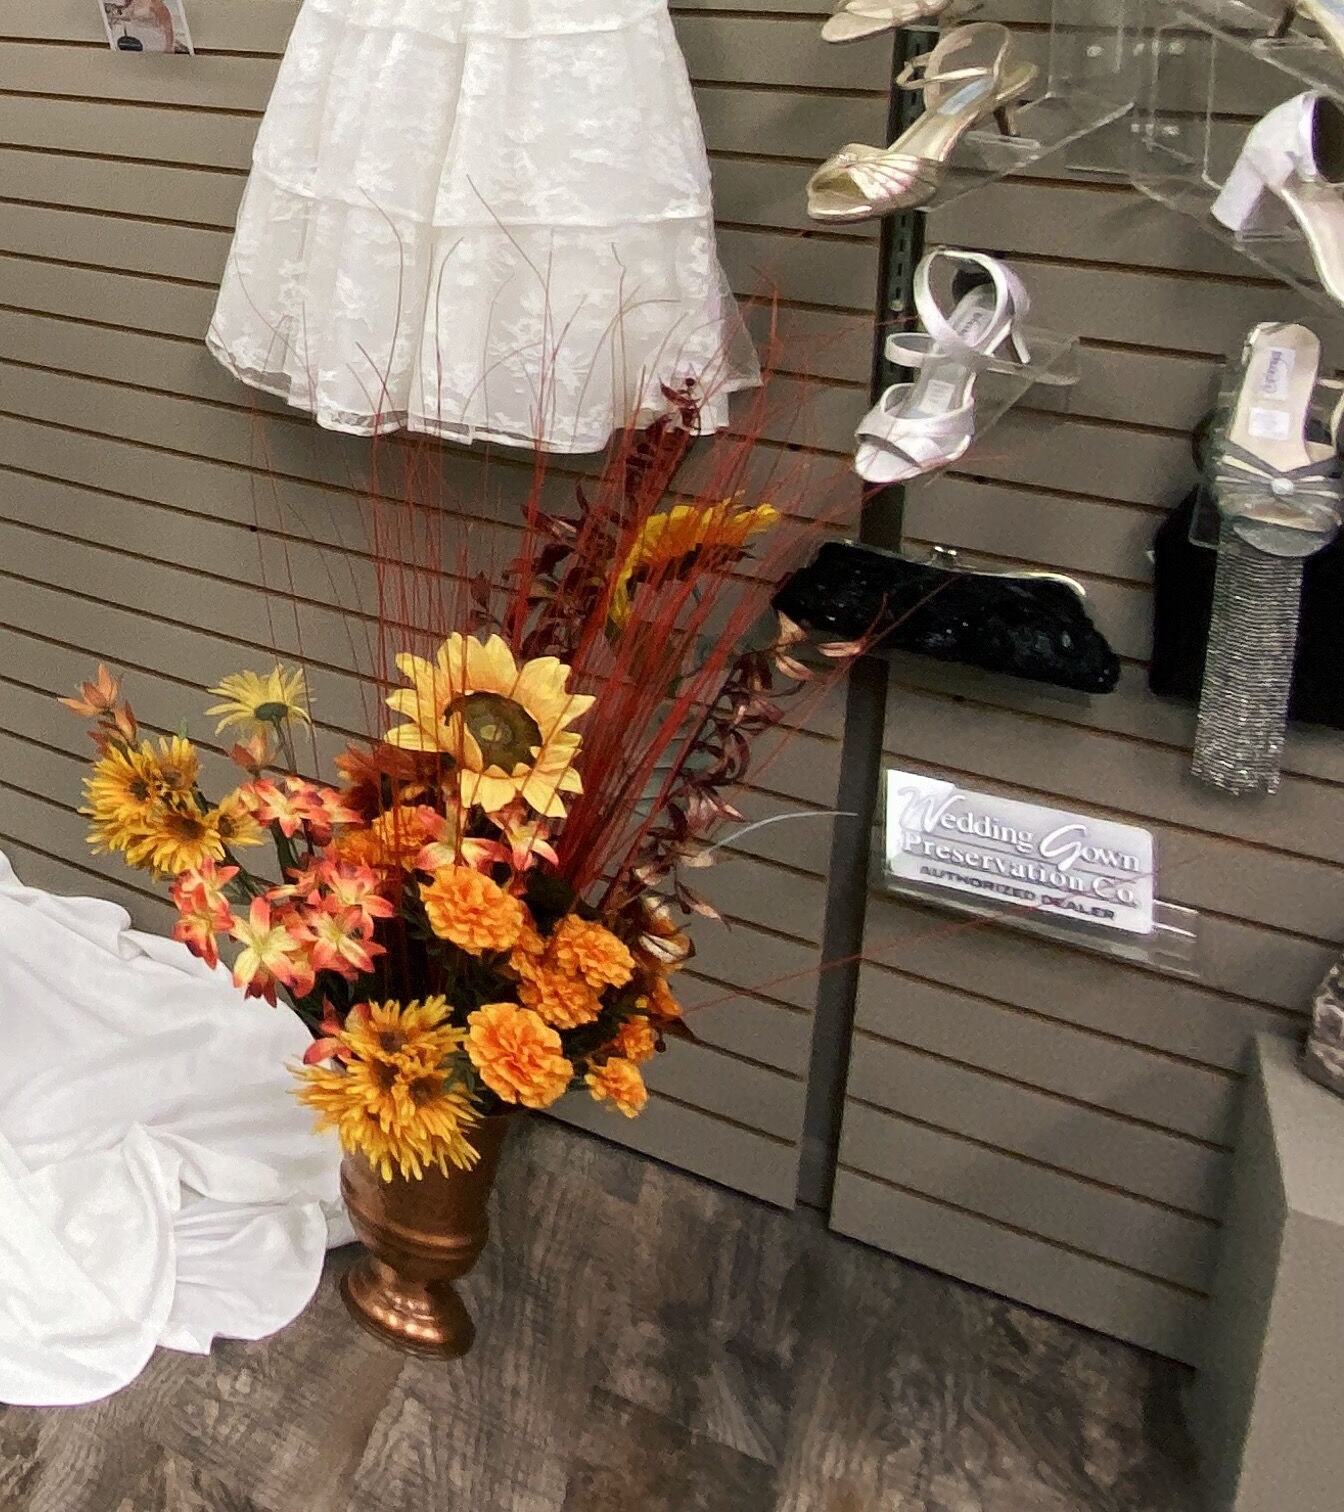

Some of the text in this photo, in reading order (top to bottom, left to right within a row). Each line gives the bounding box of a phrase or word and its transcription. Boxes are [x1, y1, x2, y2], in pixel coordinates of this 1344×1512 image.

[897, 786, 1140, 873] Wedding Gown
[902, 831, 1139, 908] Preservation Co.
[919, 865, 1116, 921] AUTHORIZED DEALER
